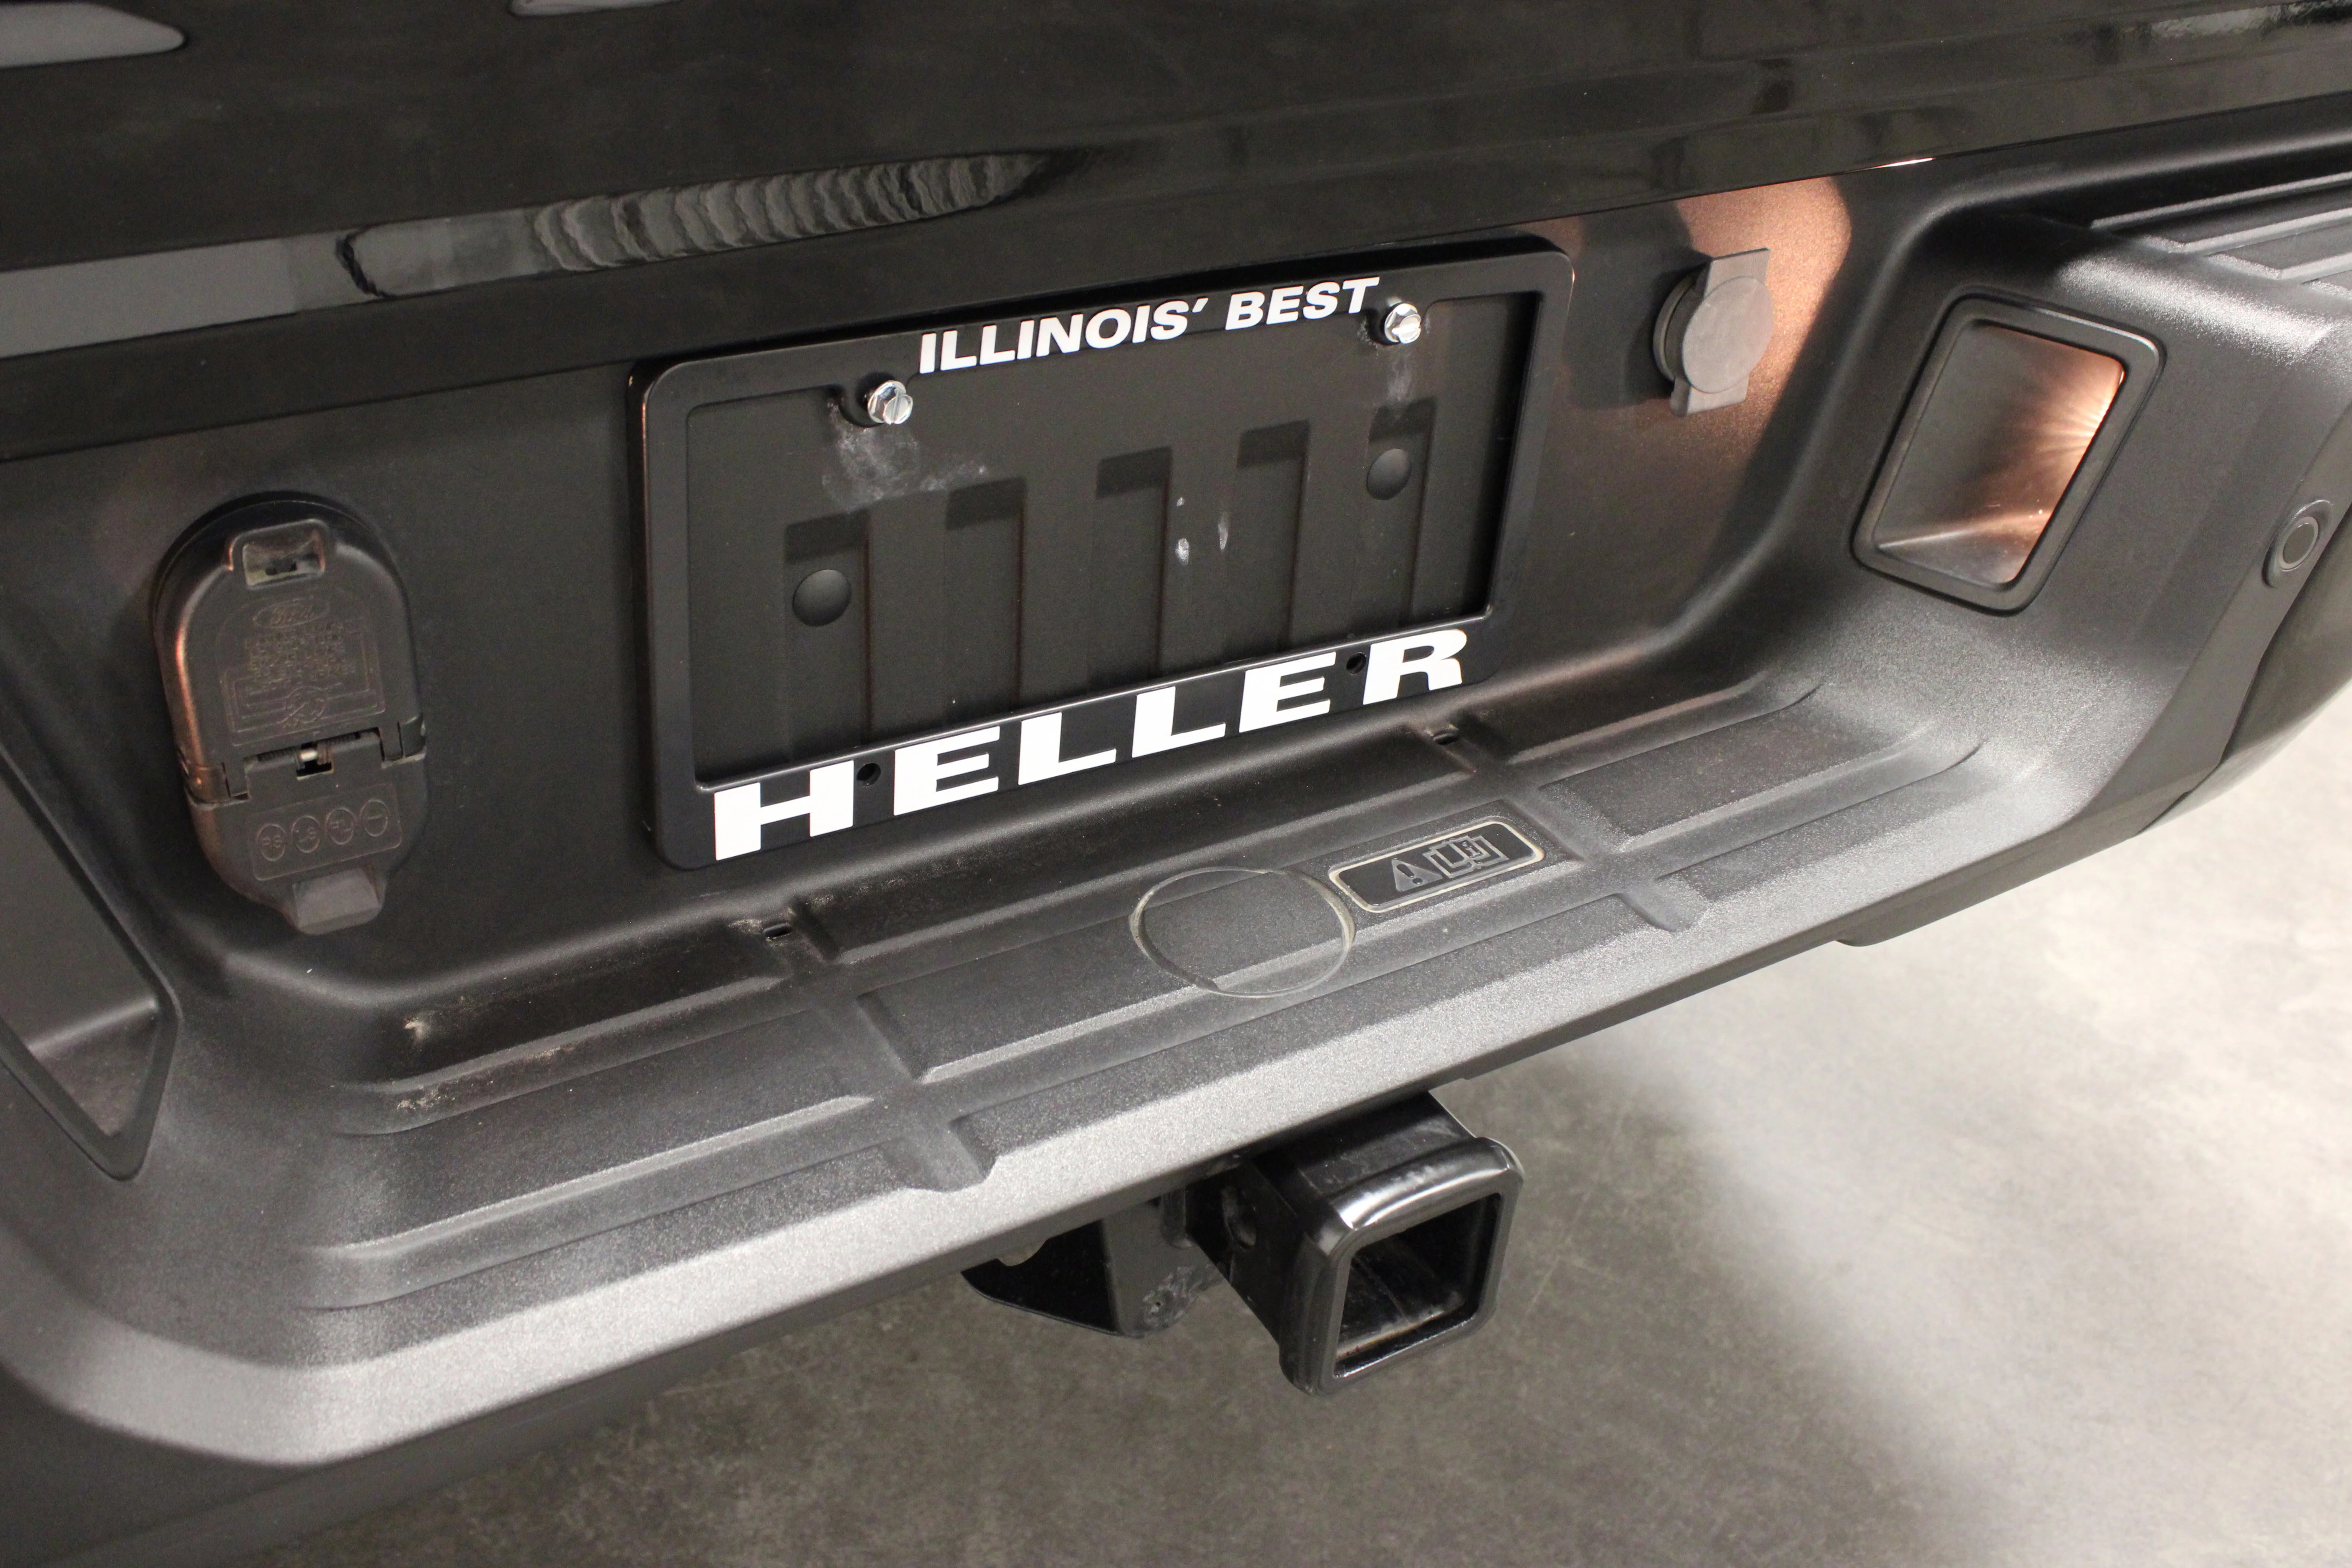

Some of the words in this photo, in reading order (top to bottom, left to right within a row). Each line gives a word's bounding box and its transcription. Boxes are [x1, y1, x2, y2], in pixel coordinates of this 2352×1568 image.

[919, 298, 1209, 374] ILLINOIS'
[1225, 277, 1380, 330] BEST
[714, 628, 1467, 861] HELLER
